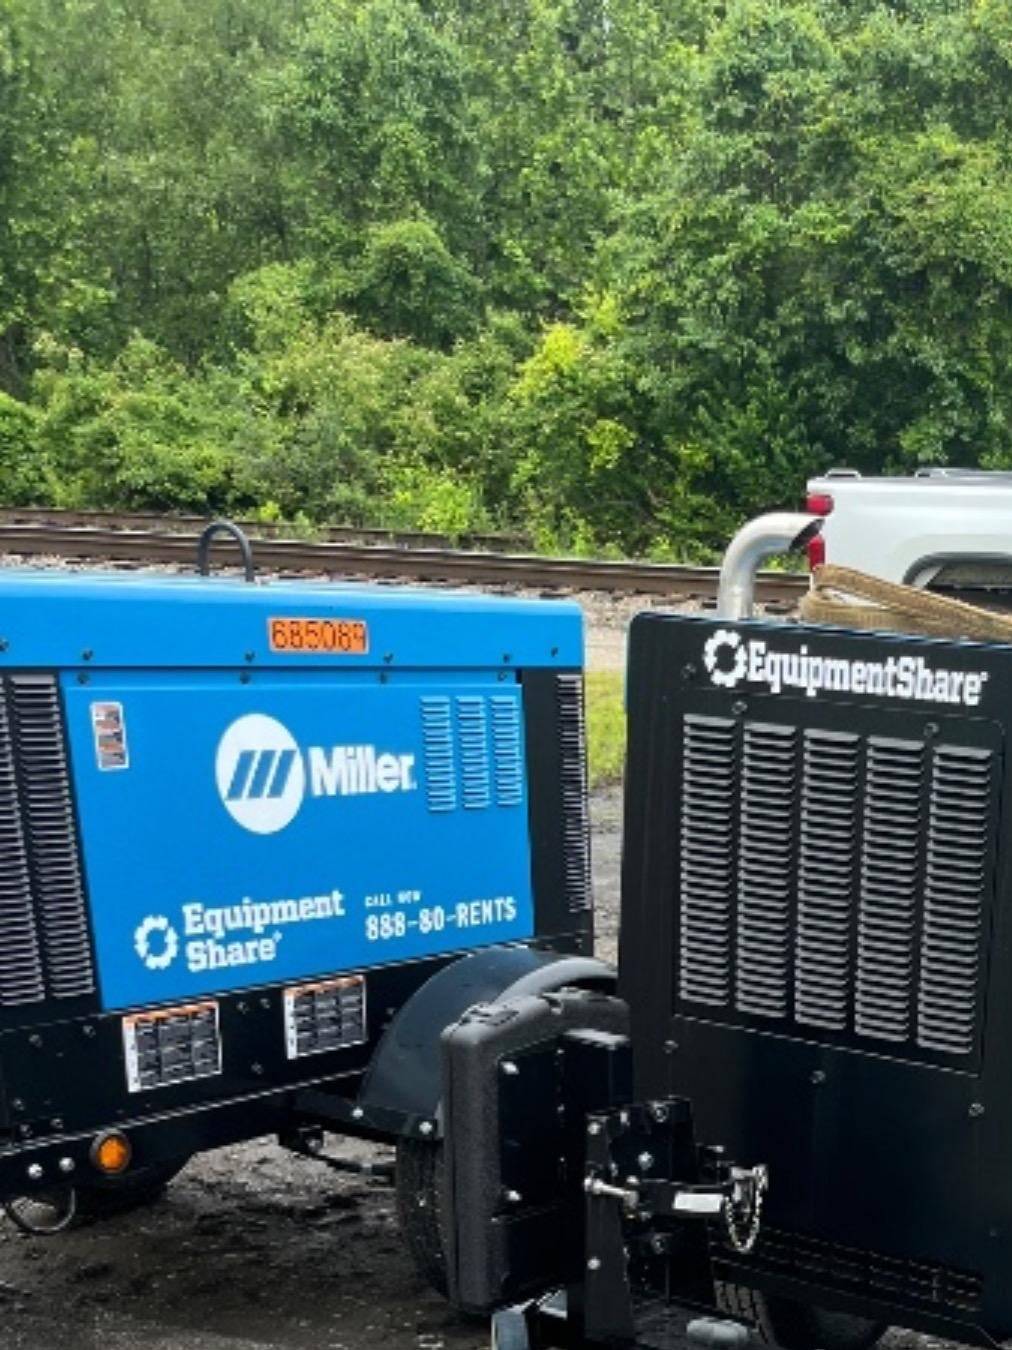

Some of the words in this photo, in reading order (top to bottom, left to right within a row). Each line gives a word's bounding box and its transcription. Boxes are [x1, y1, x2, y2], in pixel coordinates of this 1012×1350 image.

[747, 640, 982, 706] EquipmentShare
[308, 744, 415, 797] Miller
[182, 889, 345, 939] Equipment
[365, 896, 517, 941] 888-80-RENTS
[186, 936, 277, 973] Share
